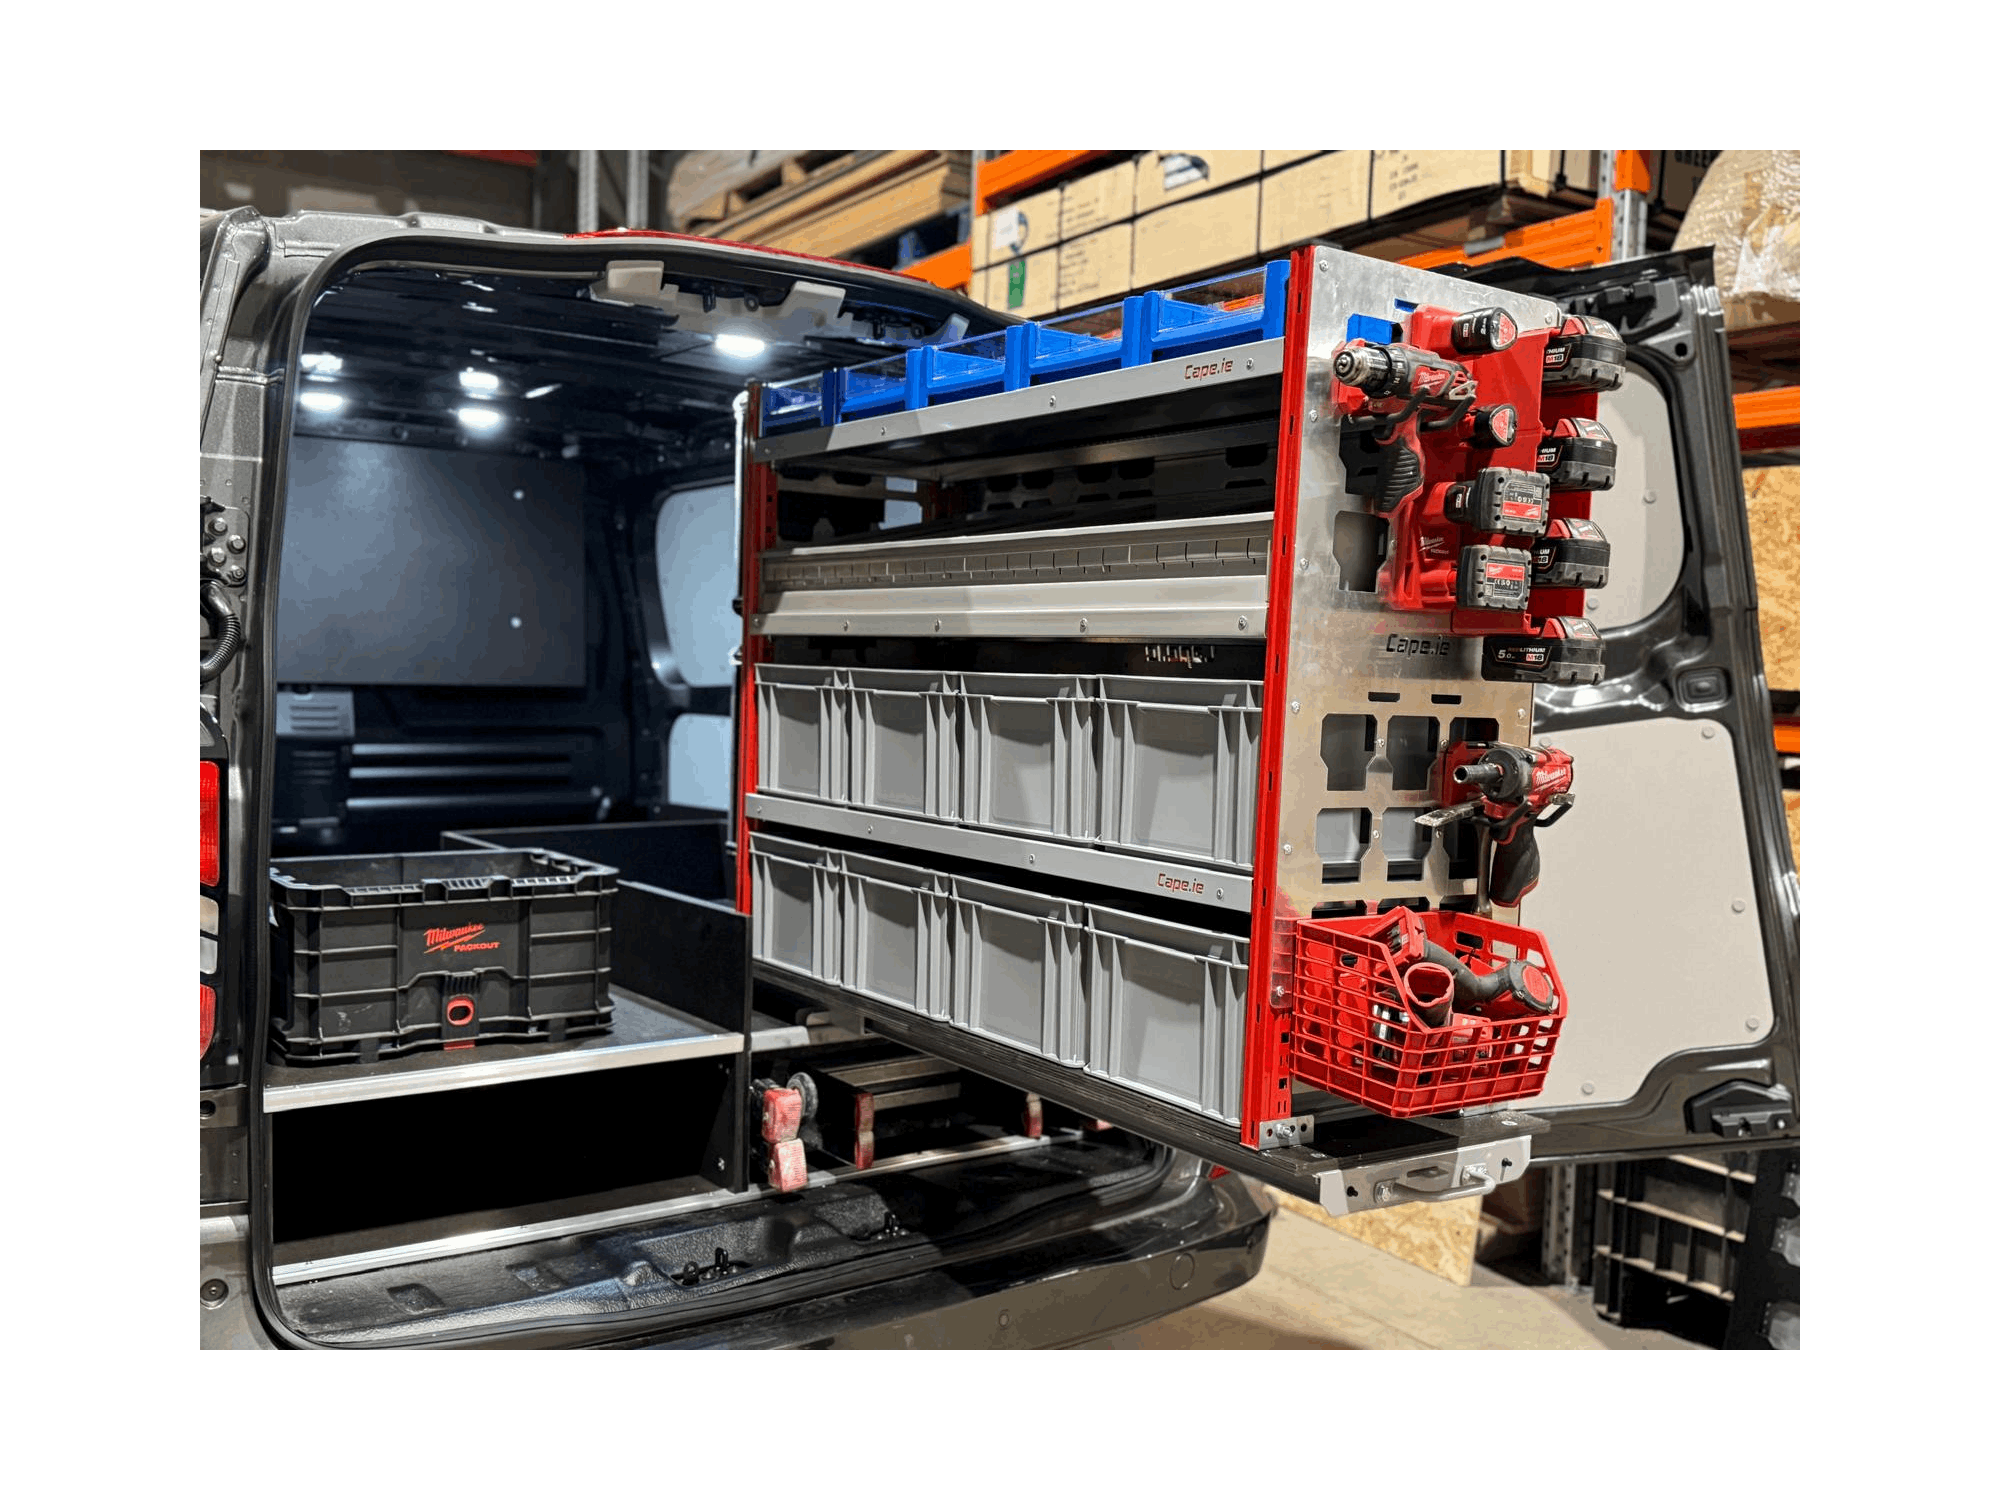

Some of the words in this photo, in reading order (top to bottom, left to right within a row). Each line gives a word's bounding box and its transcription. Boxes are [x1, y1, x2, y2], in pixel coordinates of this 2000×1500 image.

[1184, 357, 1233, 381] Cape.ie
[1386, 633, 1450, 658] Cape.ie
[1157, 873, 1204, 894] Cape.ie
[423, 923, 485, 946] Milwaukee
[454, 942, 500, 952] PACKOUT
